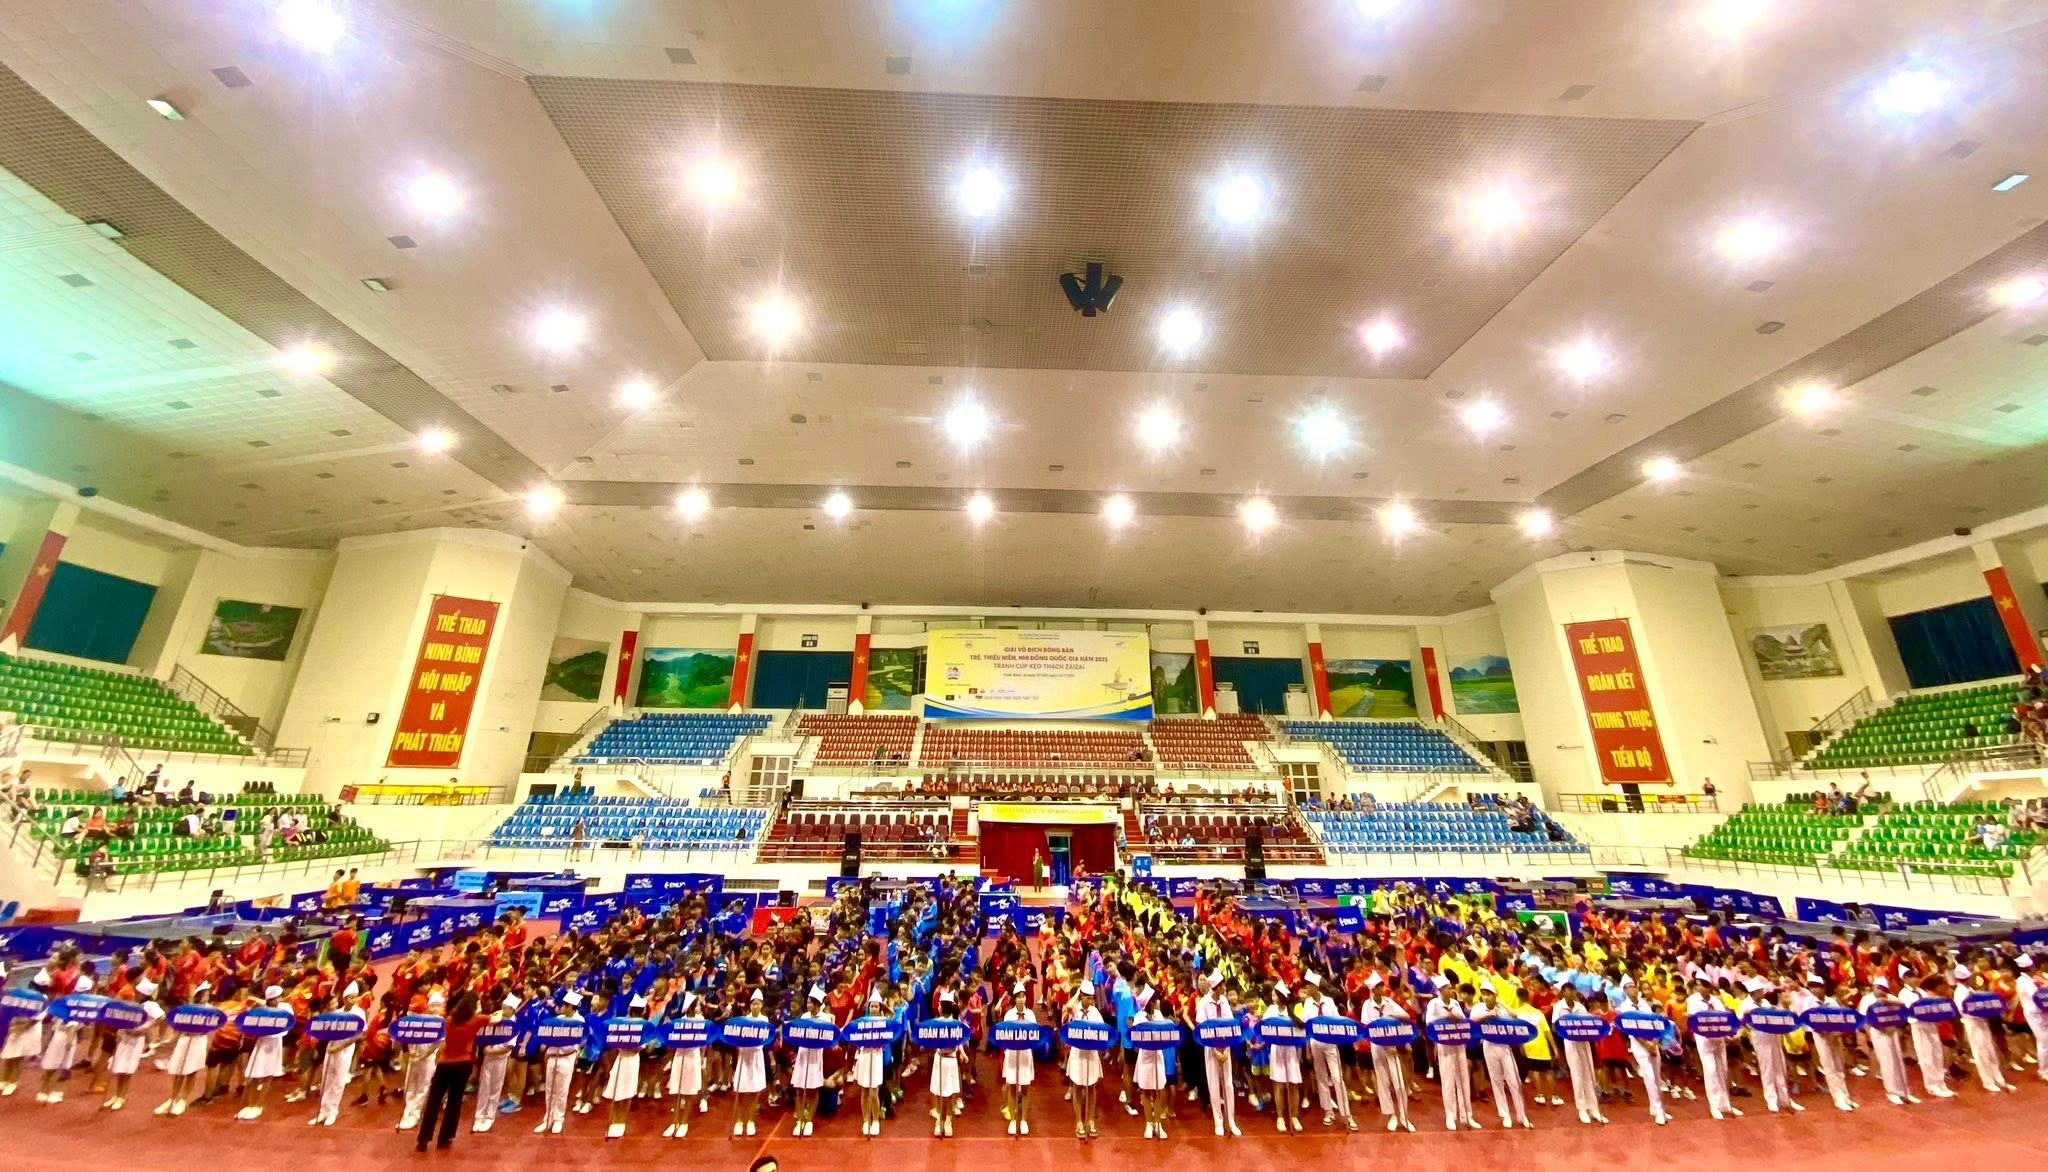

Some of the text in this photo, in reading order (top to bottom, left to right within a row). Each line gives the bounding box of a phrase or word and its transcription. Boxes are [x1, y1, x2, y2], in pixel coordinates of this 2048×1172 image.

[436, 610, 486, 636] THỂ THAO
[424, 642, 482, 664] NINH BÌNH
[1579, 632, 1624, 655] THỂ THAO
[418, 669, 472, 695] HỘI NHẬP
[1587, 668, 1635, 691] ĐOÀN KẾT
[430, 700, 445, 720] VÀ
[1591, 709, 1654, 731] TRUNG THỰC
[394, 727, 463, 752] PHÁT TRIỂN
[1610, 744, 1654, 771] TIẾN BỘ
[918, 1026, 963, 1040] ĐOÀN HÀ NỘI
[995, 1027, 1040, 1041] ĐOÀN LÀO CAI
